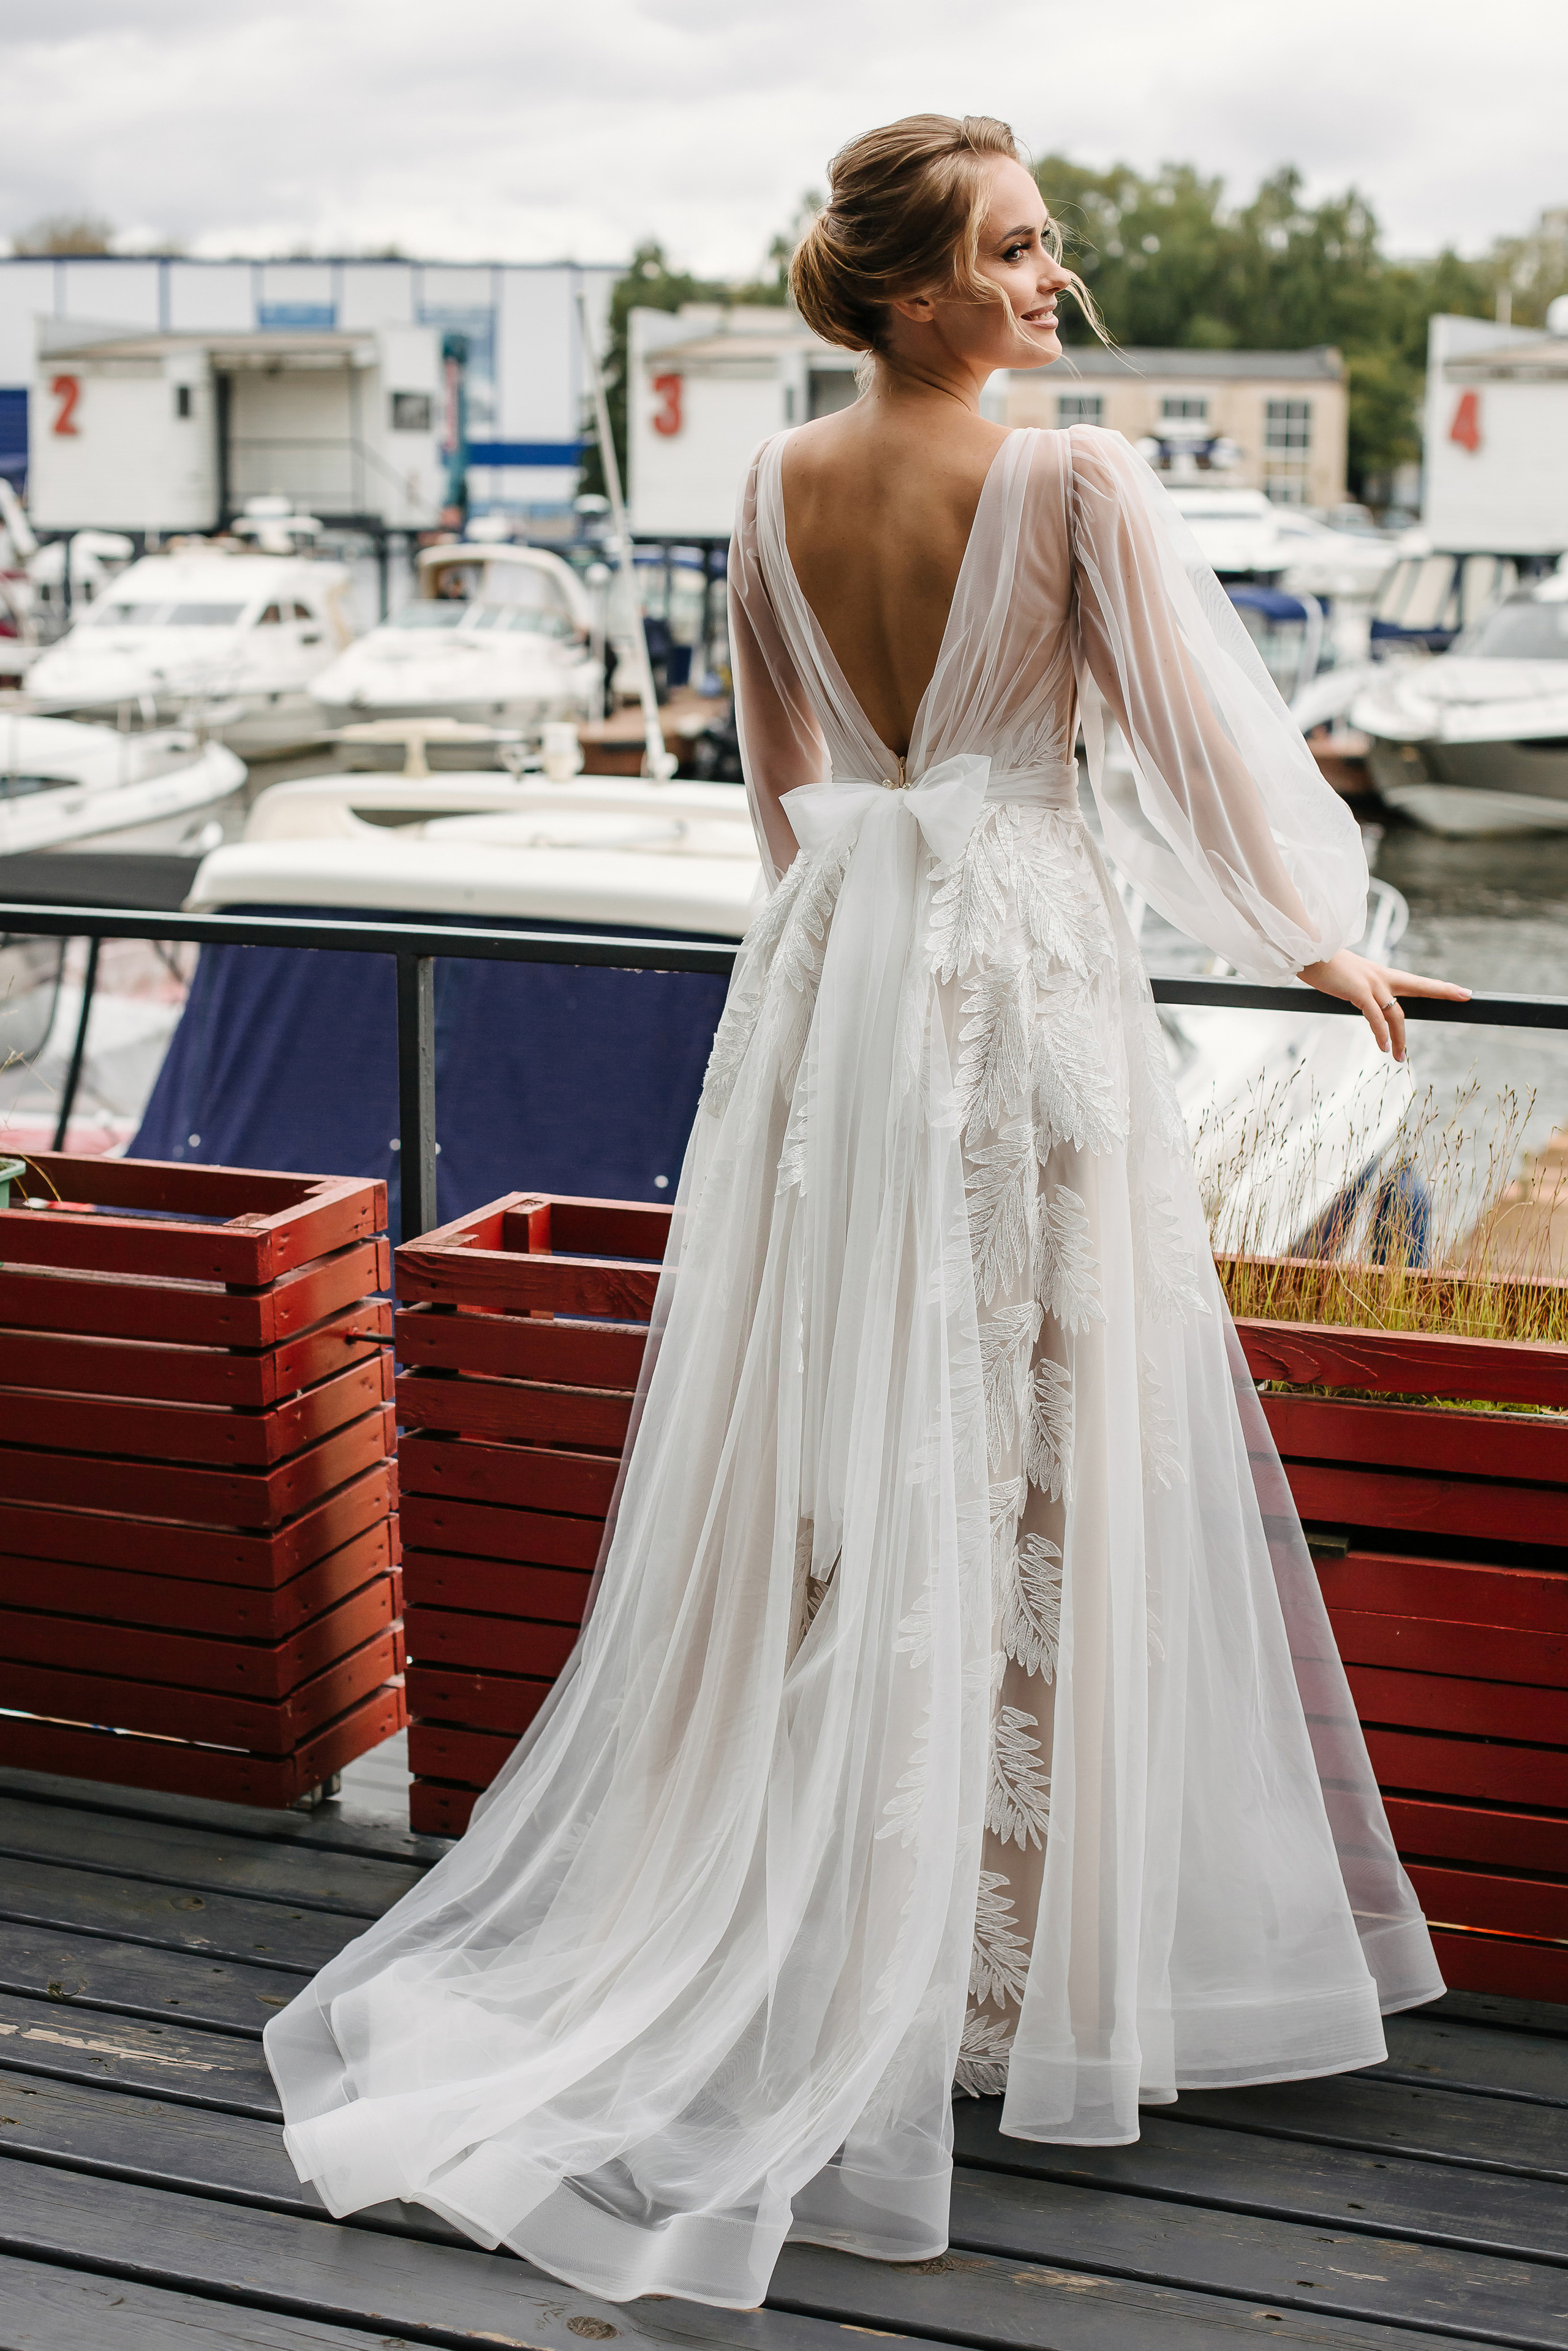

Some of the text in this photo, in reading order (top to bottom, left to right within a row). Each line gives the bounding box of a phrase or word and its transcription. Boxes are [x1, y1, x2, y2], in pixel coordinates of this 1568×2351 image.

[50, 374, 81, 437] 2
[650, 372, 684, 438] 3
[1448, 388, 1482, 453] 4
